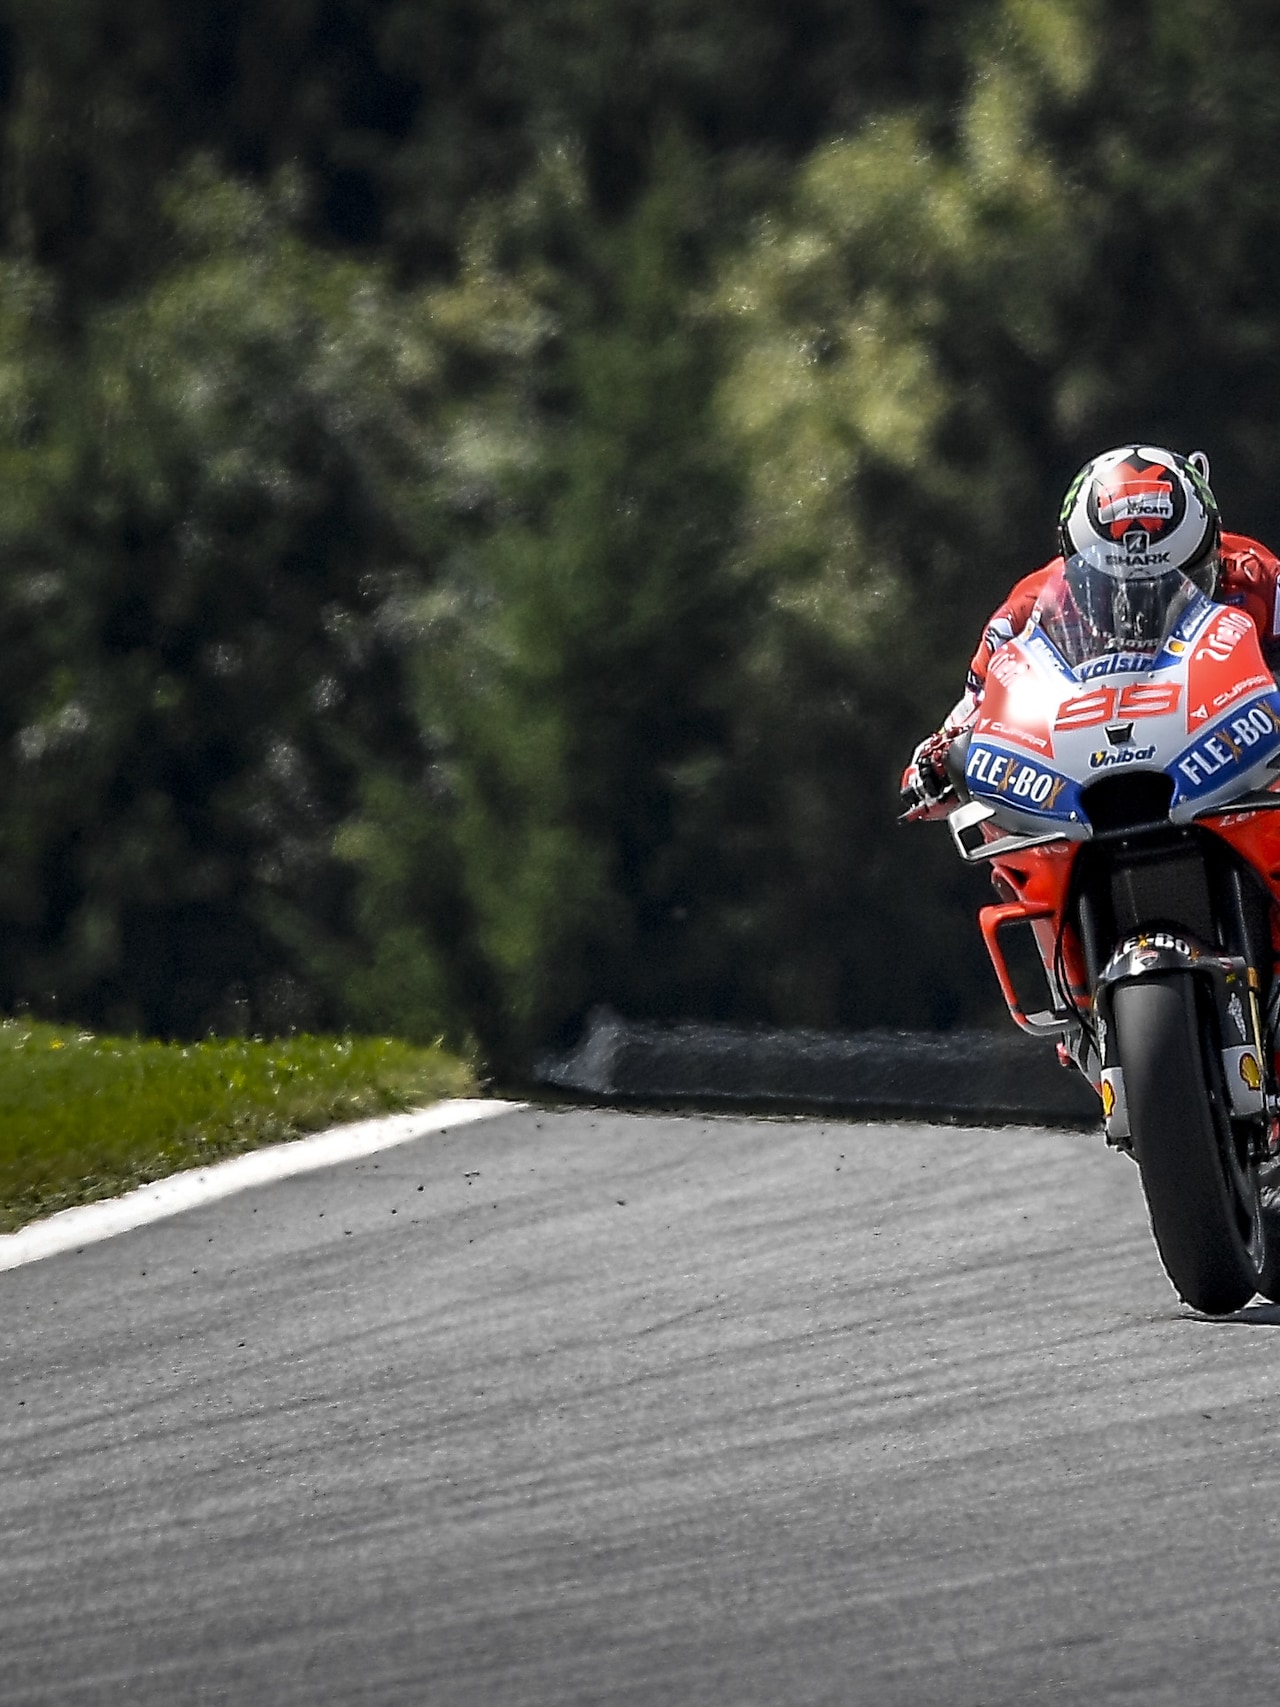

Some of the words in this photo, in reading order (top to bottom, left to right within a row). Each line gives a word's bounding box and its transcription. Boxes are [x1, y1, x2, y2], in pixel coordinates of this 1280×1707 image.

[1105, 552, 1171, 566] SHARK
[1081, 654, 1155, 679] valsir
[1054, 681, 1182, 732] 99
[1089, 745, 1157, 768] Unibat
[967, 748, 1067, 809] FLEX-BOX
